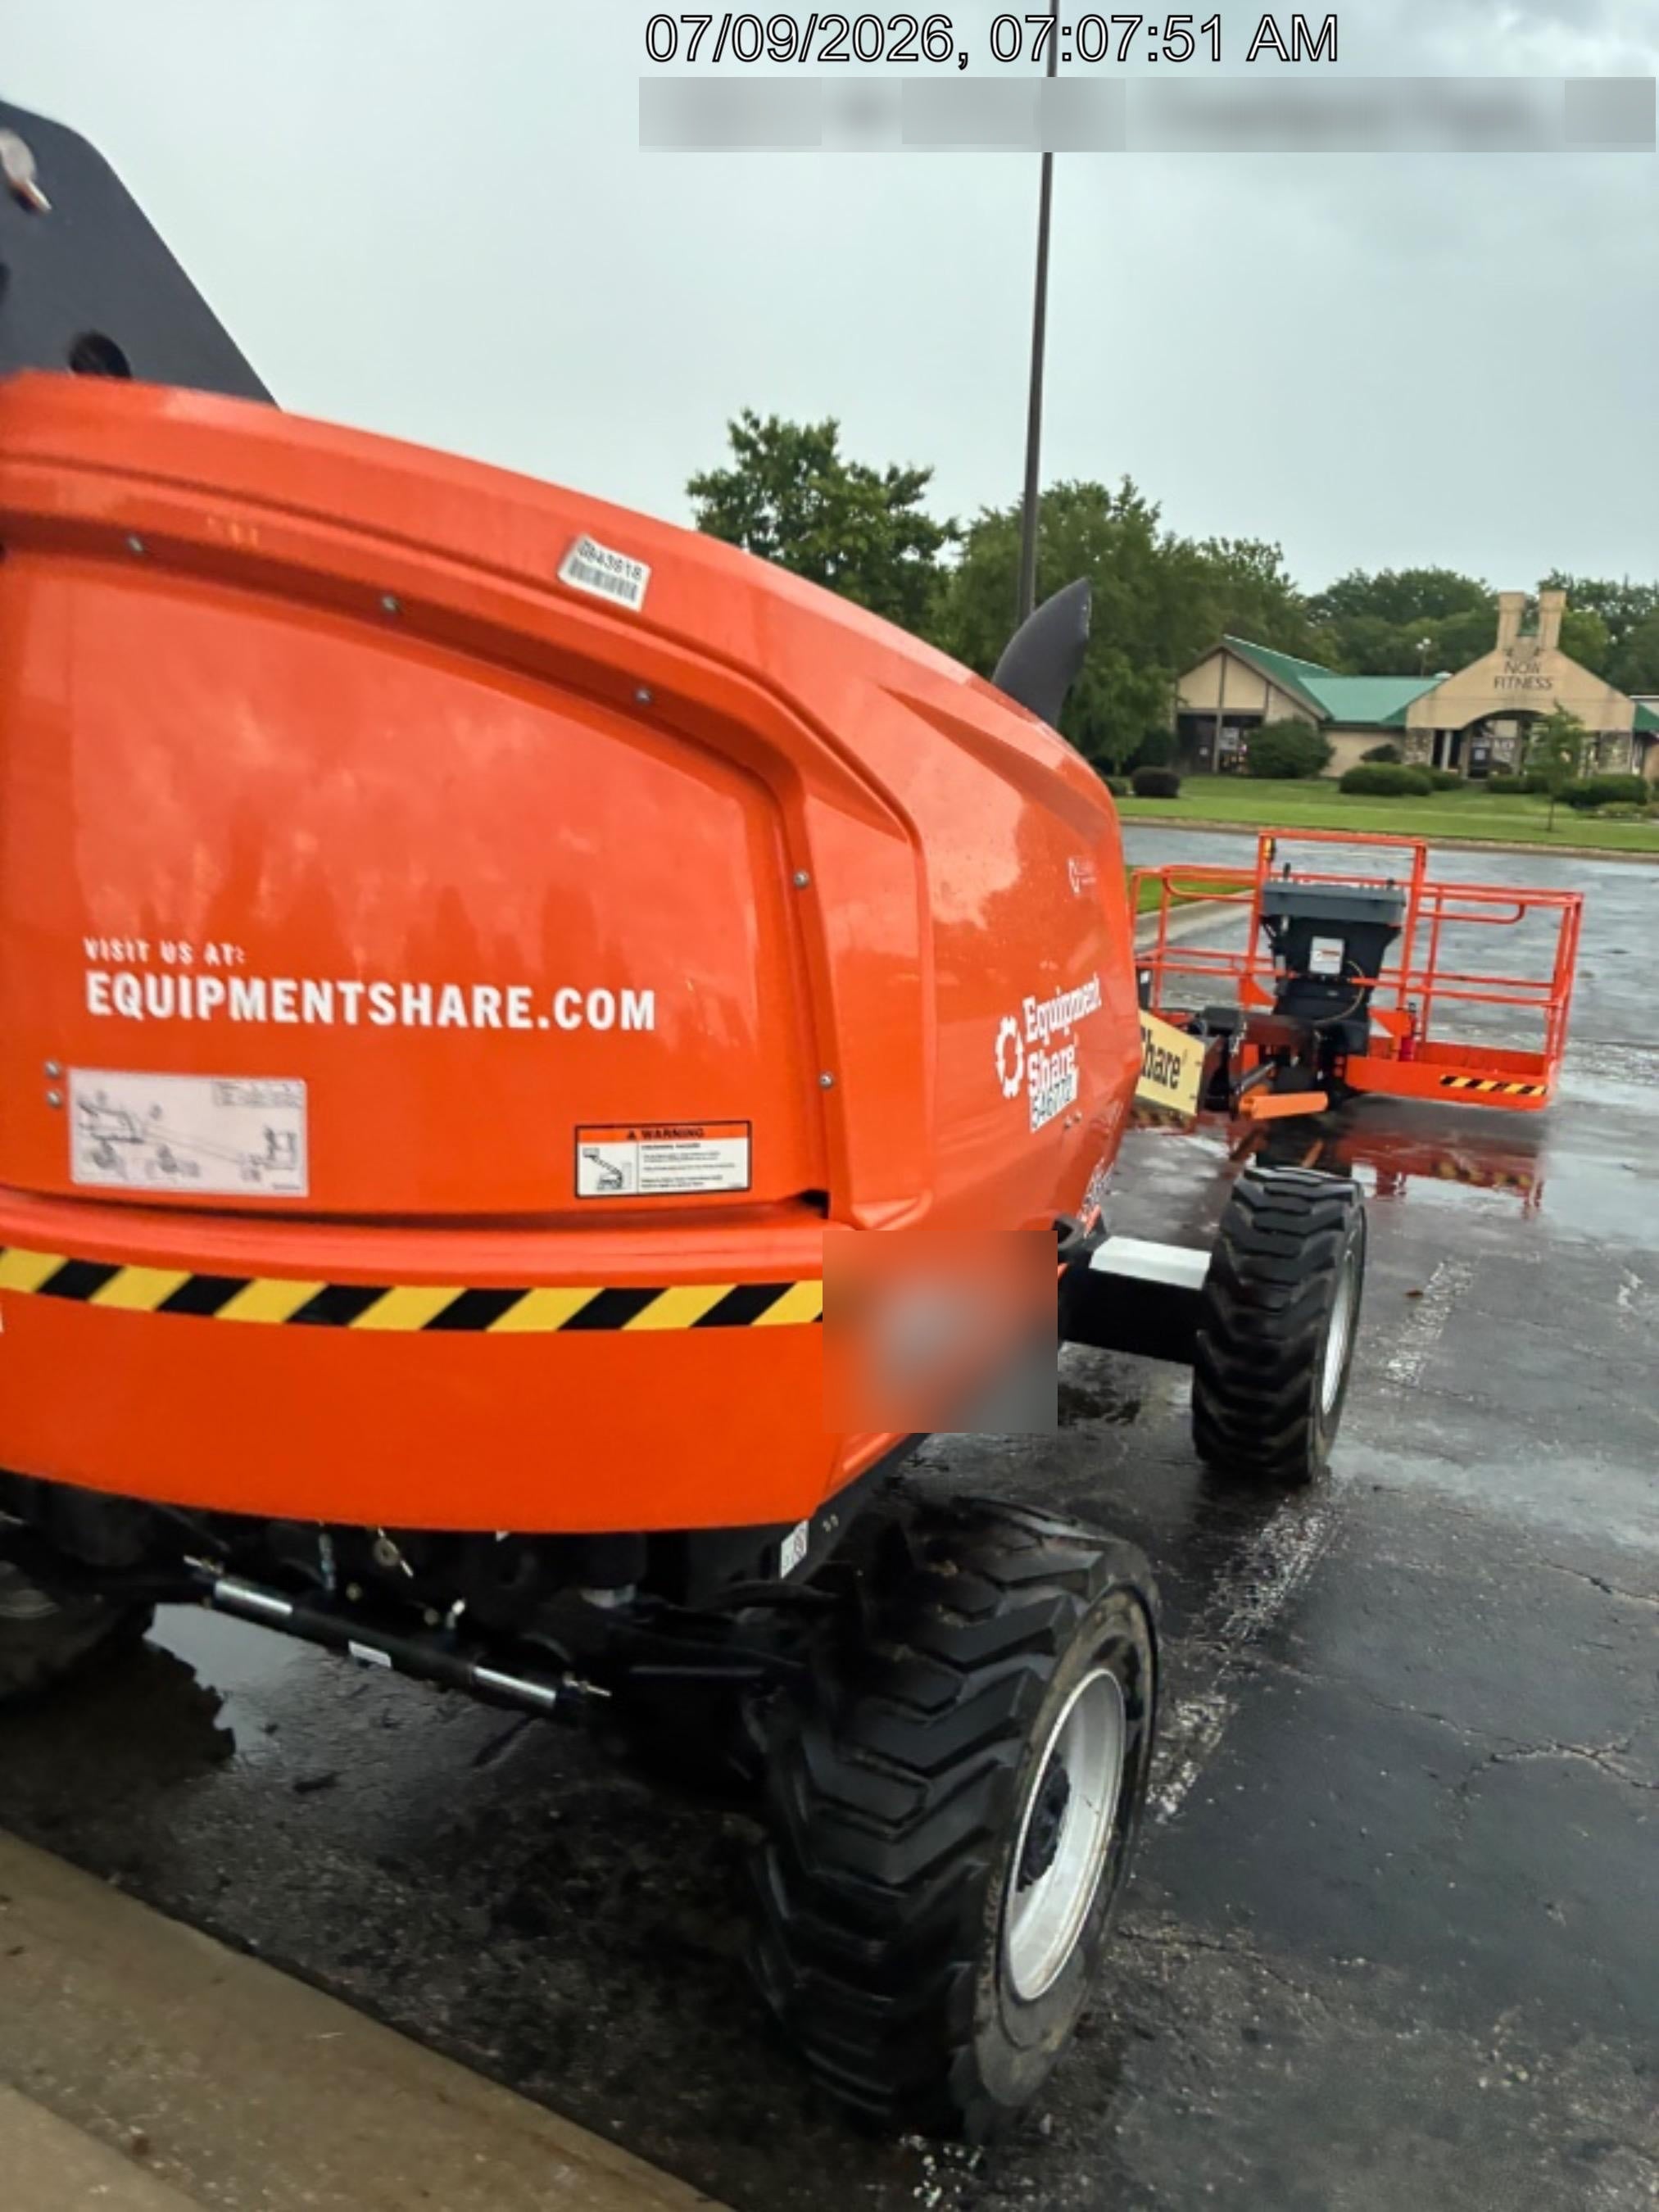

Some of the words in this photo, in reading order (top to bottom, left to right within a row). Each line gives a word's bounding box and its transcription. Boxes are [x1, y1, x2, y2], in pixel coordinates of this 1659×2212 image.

[1494, 675, 1554, 691] FITNESS
[84, 937, 151, 963] VISIT
[160, 940, 193, 965] US
[85, 969, 656, 1031] EQUIPMENTSHARE.COM
[1022, 972, 1103, 1044] Equipment
[641, 1127, 705, 1140] WARNING
